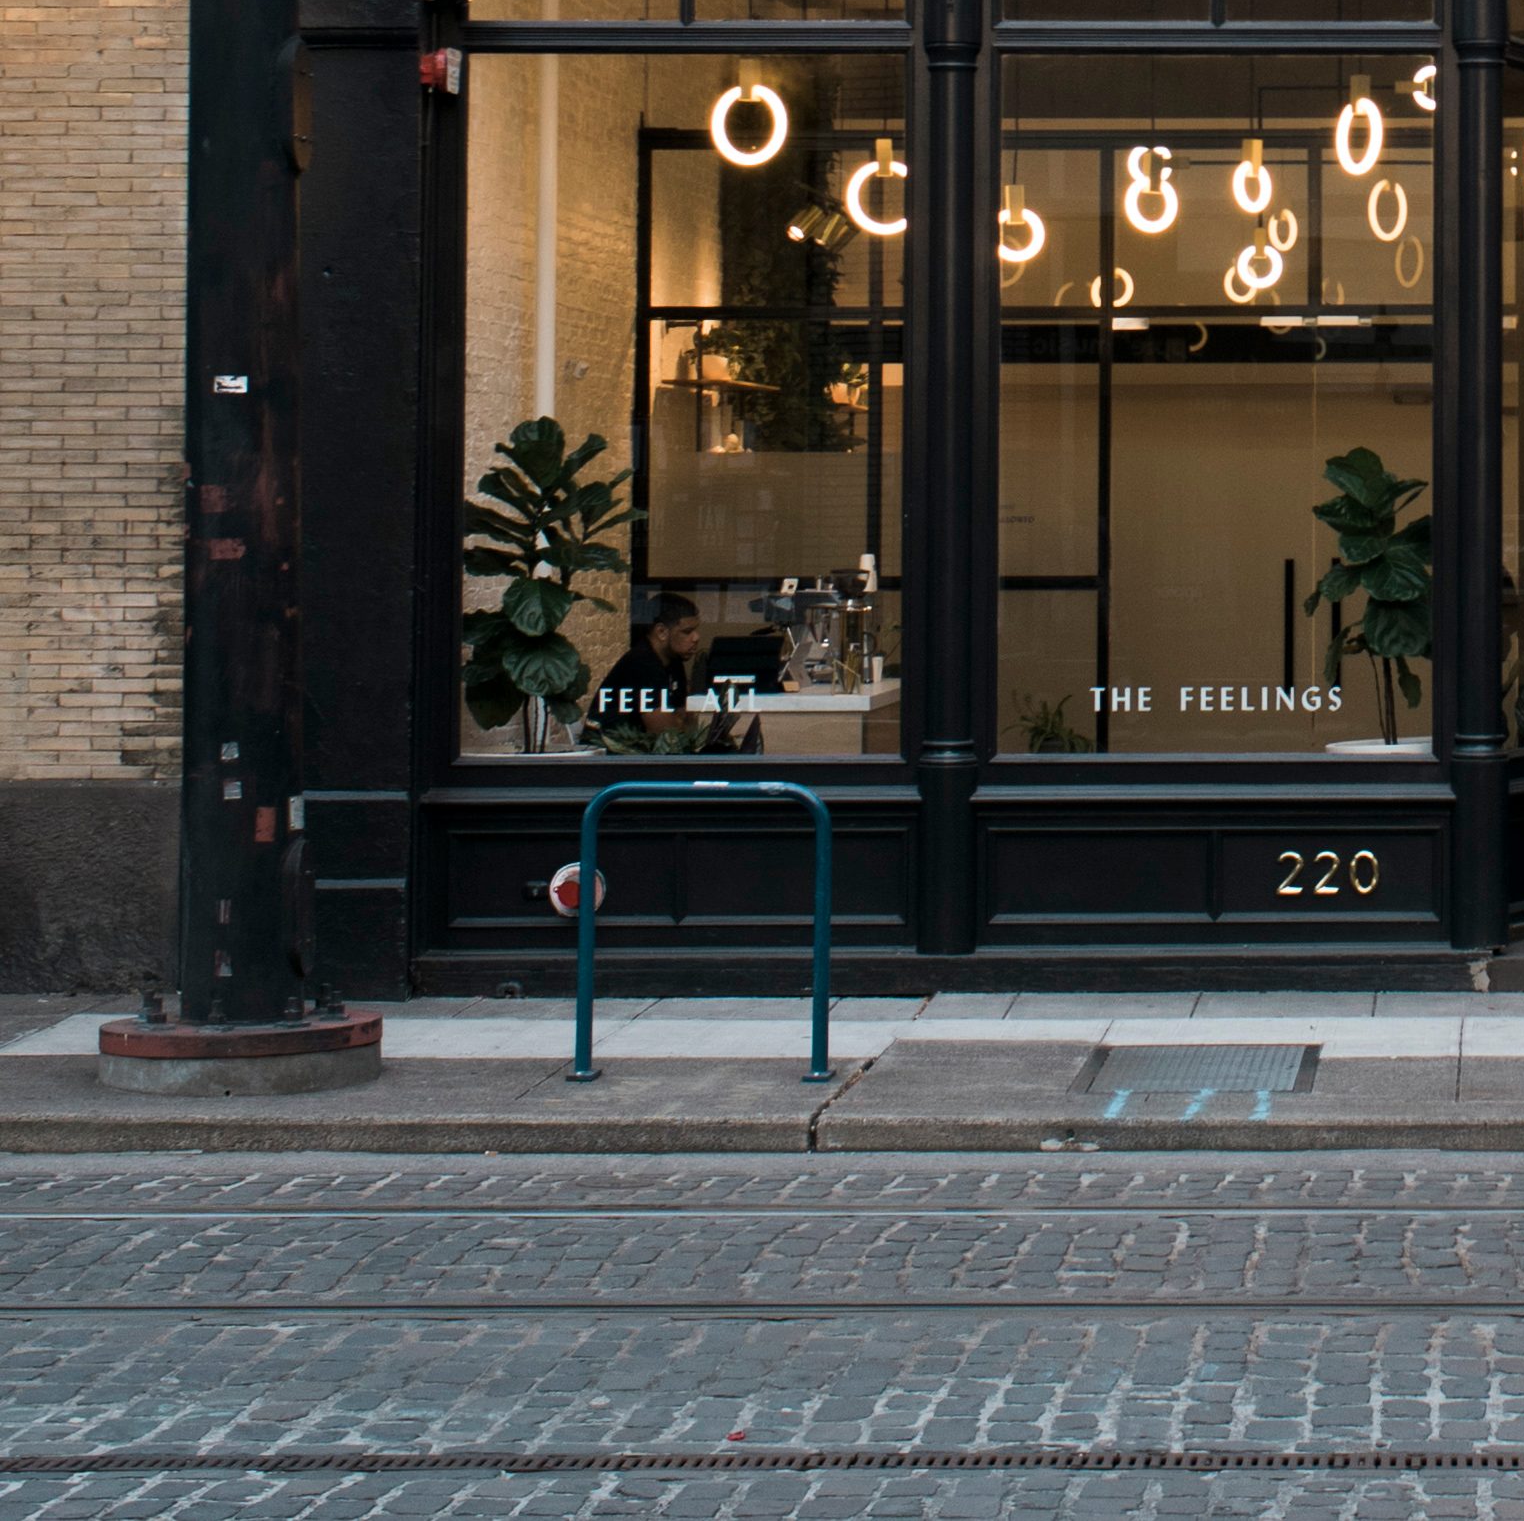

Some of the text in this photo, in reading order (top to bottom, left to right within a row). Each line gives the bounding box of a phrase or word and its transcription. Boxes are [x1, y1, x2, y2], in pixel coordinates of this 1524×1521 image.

[599, 688, 762, 713] FEEL ALL
[1090, 686, 1342, 712] THE FEELINGS
[1276, 850, 1381, 896] 220
